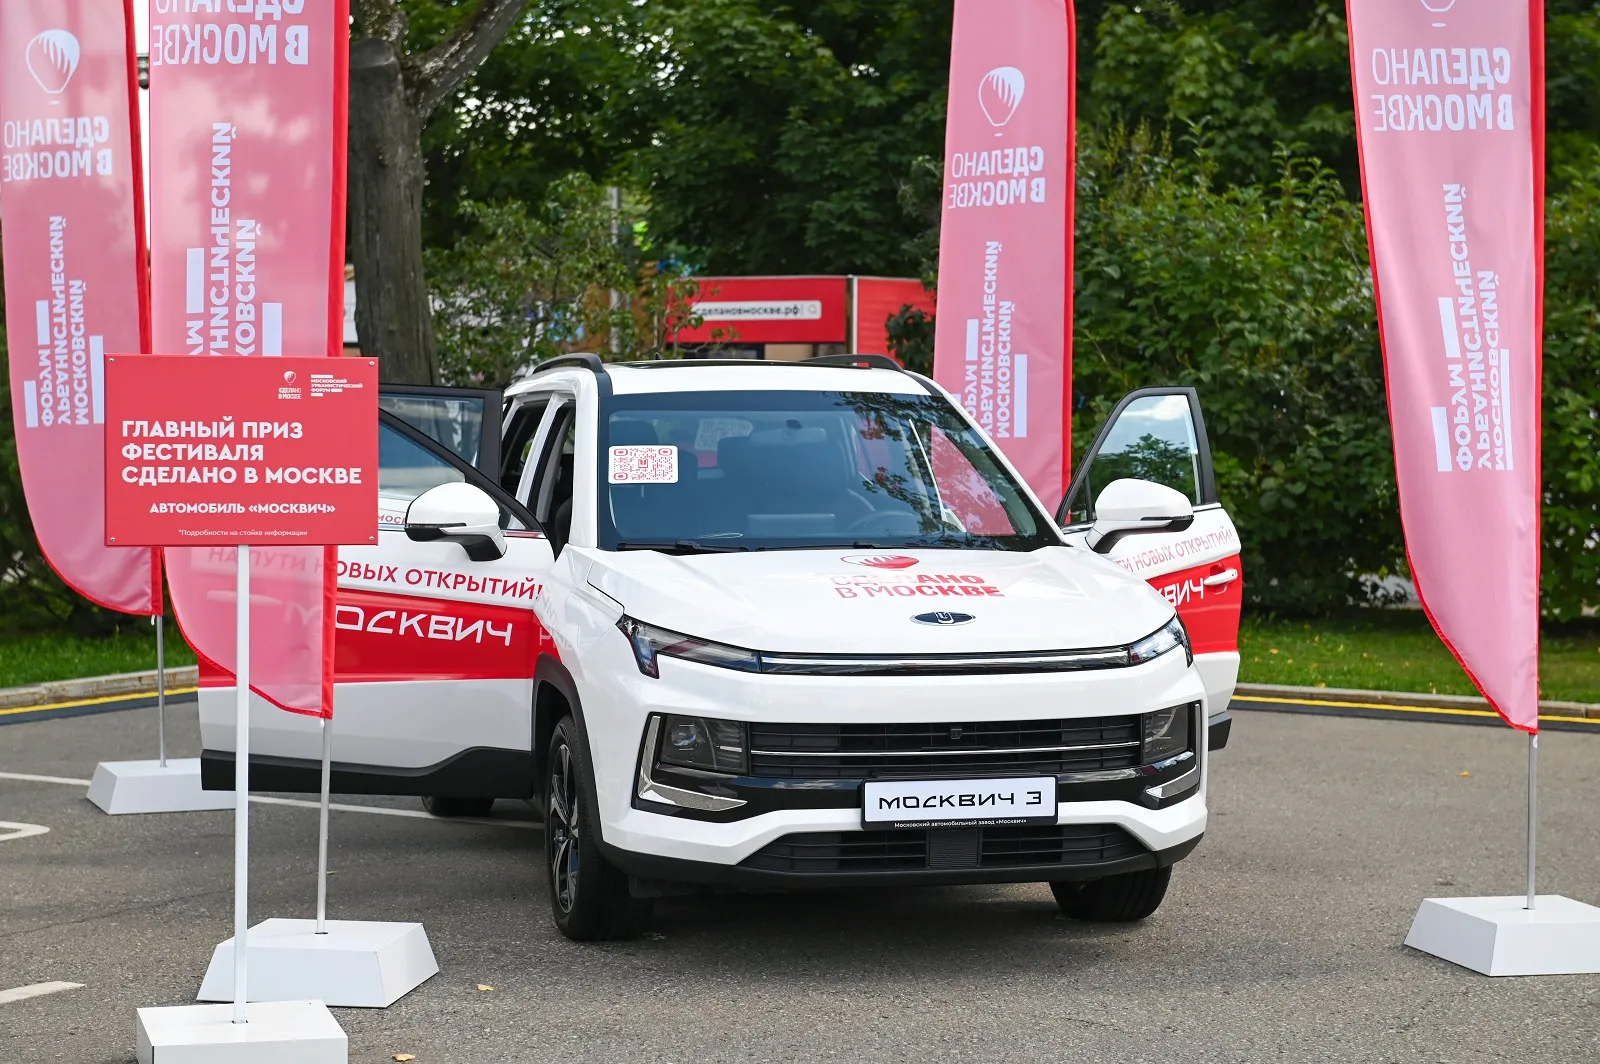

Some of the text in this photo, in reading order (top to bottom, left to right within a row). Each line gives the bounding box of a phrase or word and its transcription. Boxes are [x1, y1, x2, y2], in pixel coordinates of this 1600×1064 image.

[122, 416, 303, 439] ГЛАВНЫЙ ПРИЗ
[121, 443, 264, 461] ФЕСТИВАЛЯ
[121, 466, 361, 486] СДЕЛАНО В МОСКВЕ
[150, 502, 336, 514] АВТОМОБИЛЬ «МОСКВИЧ»
[1132, 545, 1176, 570] НОВЫХ
[1174, 525, 1235, 557] ОТКРЫТИЙ!
[405, 569, 543, 600] ОТКРЫТИЙ!
[835, 585, 1005, 598] В МОСКВЕ
[879, 791, 1042, 809] МОСКВИЧ 3
[931, 819, 978, 828] автомобильный
